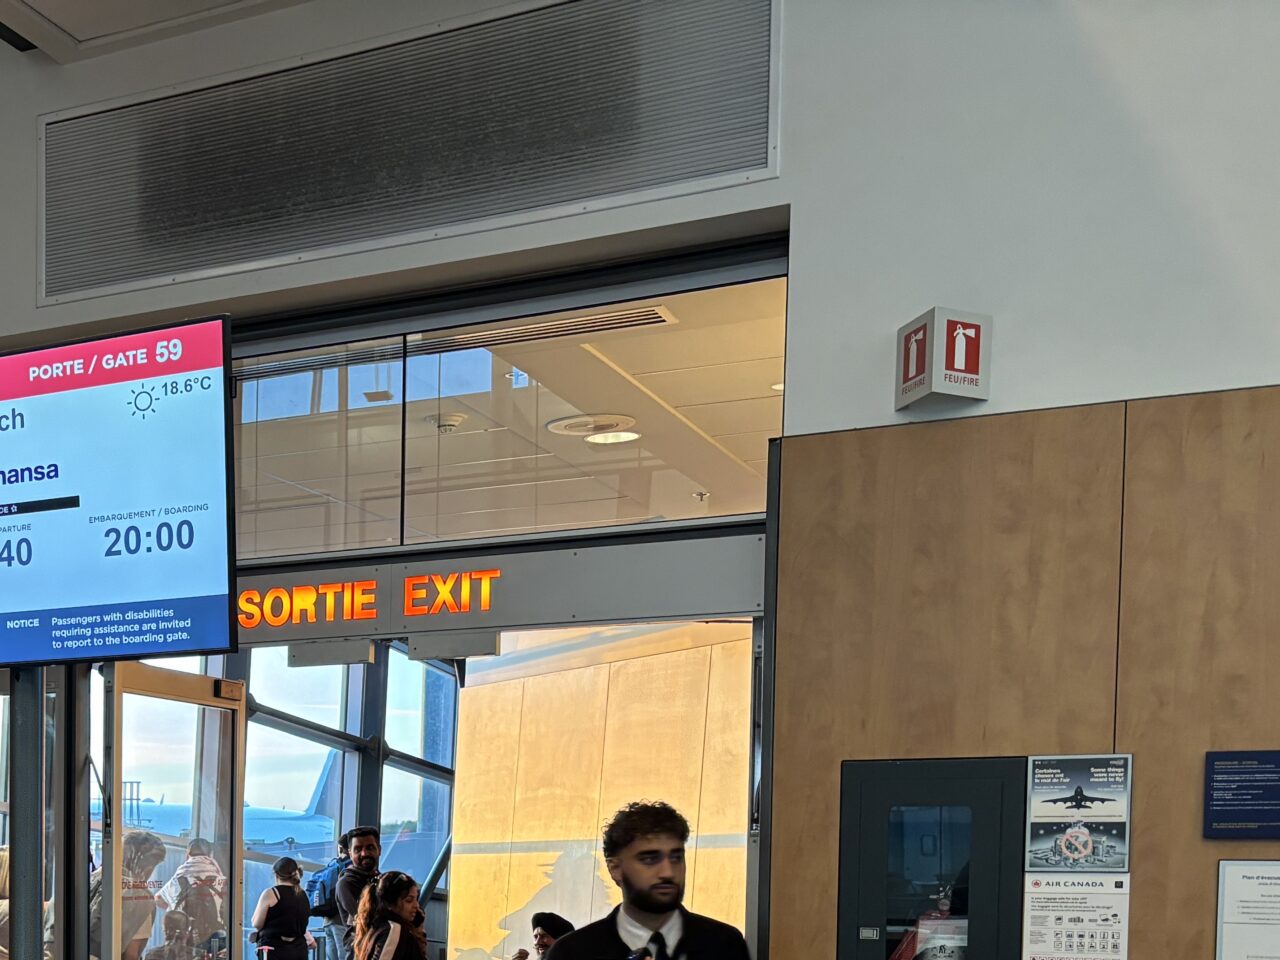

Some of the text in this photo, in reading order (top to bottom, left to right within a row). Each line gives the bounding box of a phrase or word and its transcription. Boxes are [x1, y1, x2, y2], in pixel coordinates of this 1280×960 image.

[29, 359, 84, 382] PORTE
[102, 349, 148, 370] GATE
[155, 338, 183, 362] 59
[161, 376, 212, 396] 18.6°C
[944, 373, 980, 387] FEU/FIRE
[88, 509, 156, 524] EMBARQUEMENT
[164, 504, 208, 516] BOARDING
[104, 520, 194, 557] 20:00
[238, 568, 501, 628] SORTIE EXIT
[6, 618, 40, 628] NOTICE
[52, 608, 174, 626] Passengers with disabilities
[52, 618, 190, 638] requiring assistance are invited
[52, 631, 190, 649] to report to the boarding gate.
